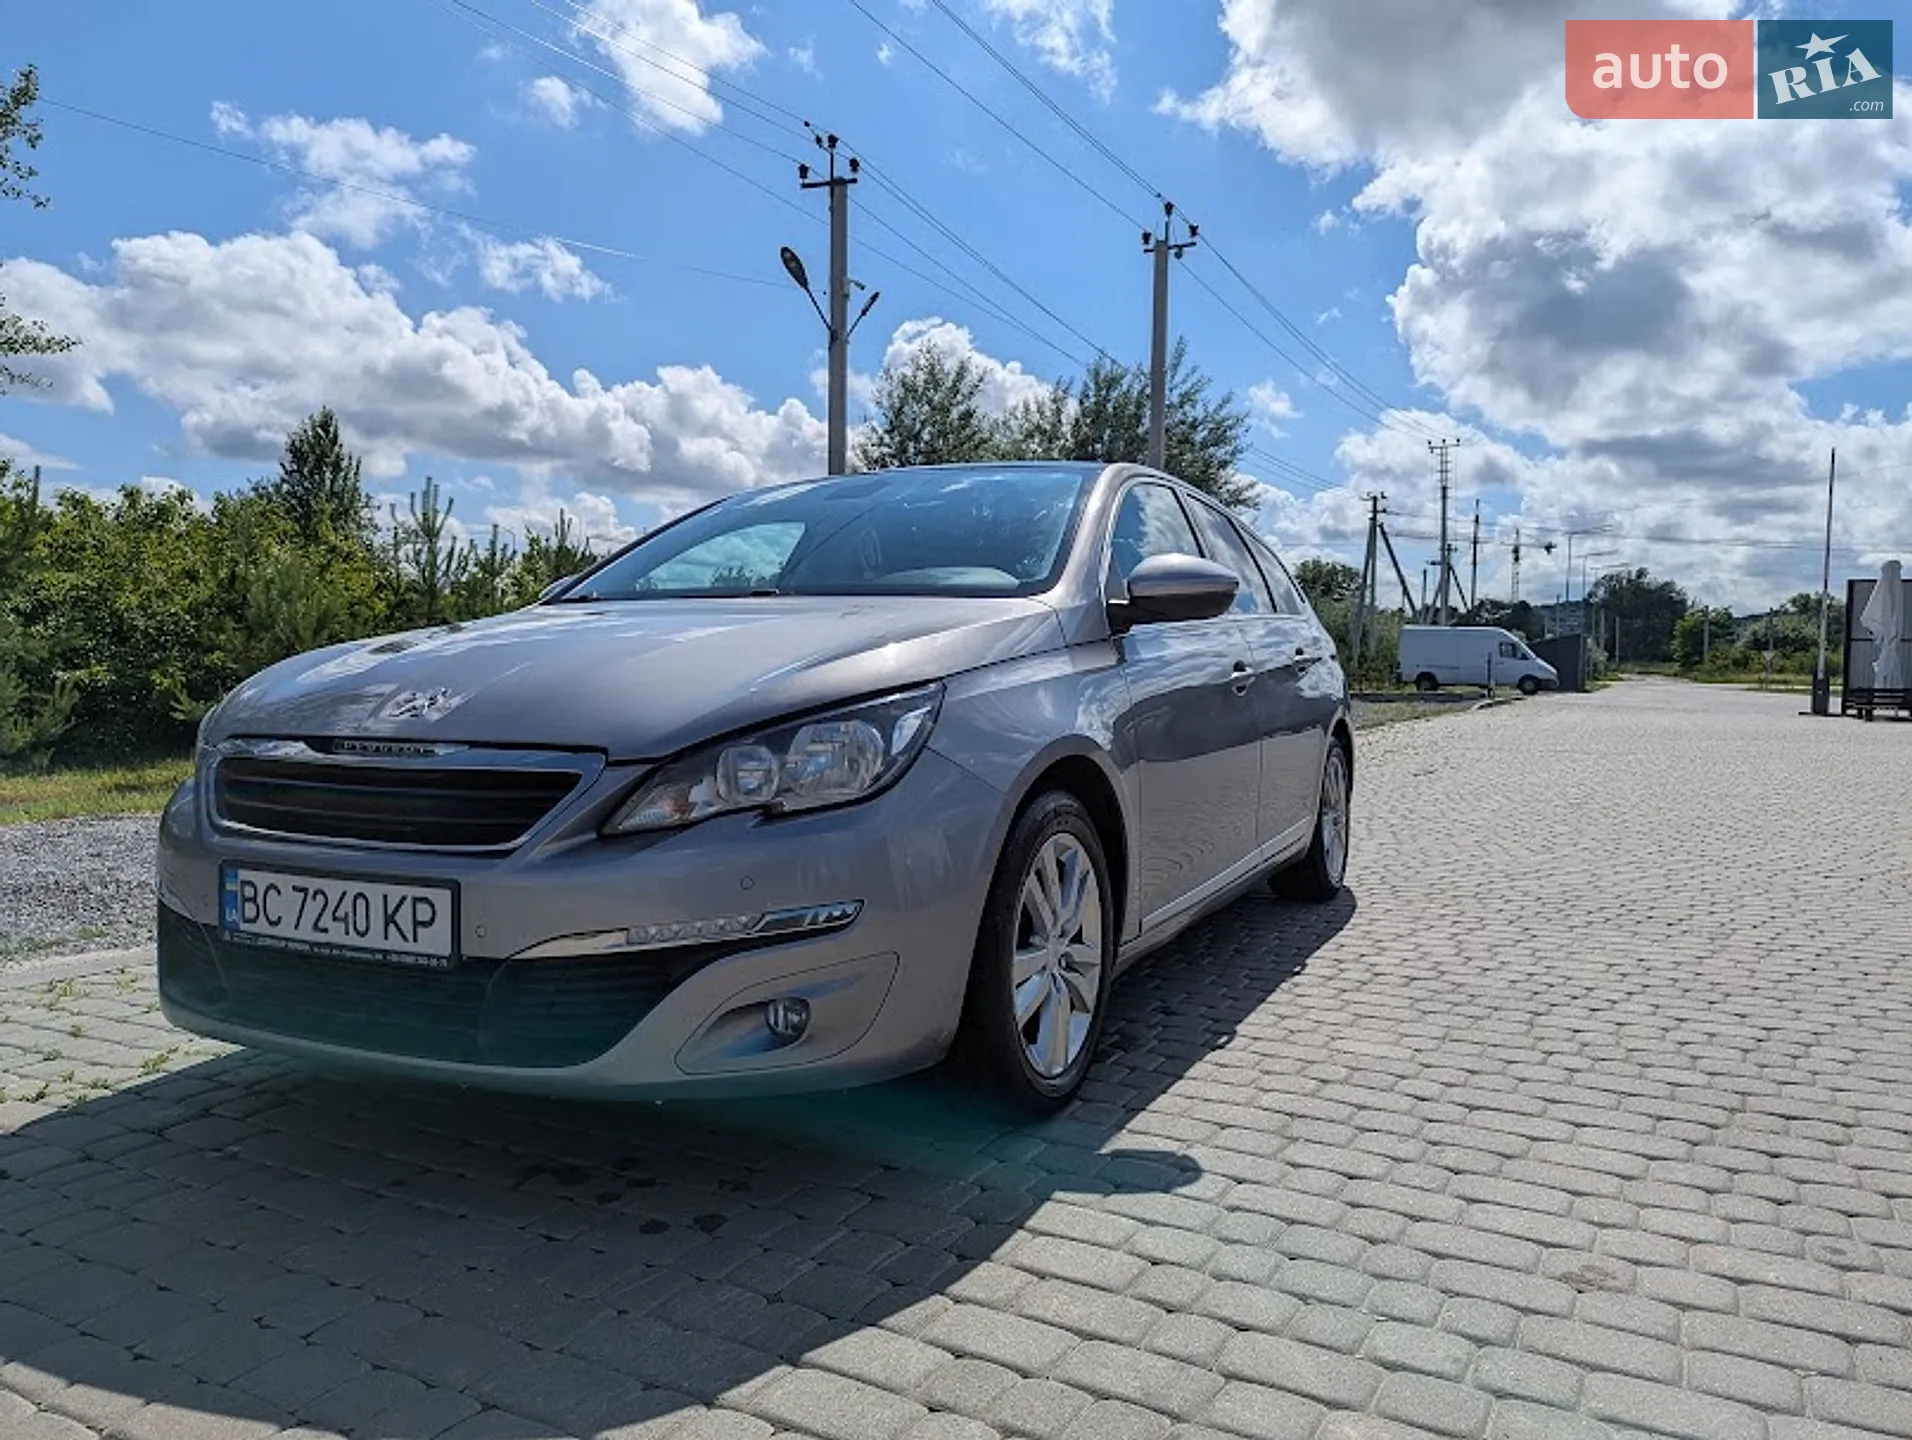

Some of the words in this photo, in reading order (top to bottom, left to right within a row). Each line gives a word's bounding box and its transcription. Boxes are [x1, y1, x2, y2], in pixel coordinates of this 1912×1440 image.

[240, 880, 283, 927] BC
[292, 885, 370, 938] 7240
[383, 893, 437, 943] KP
